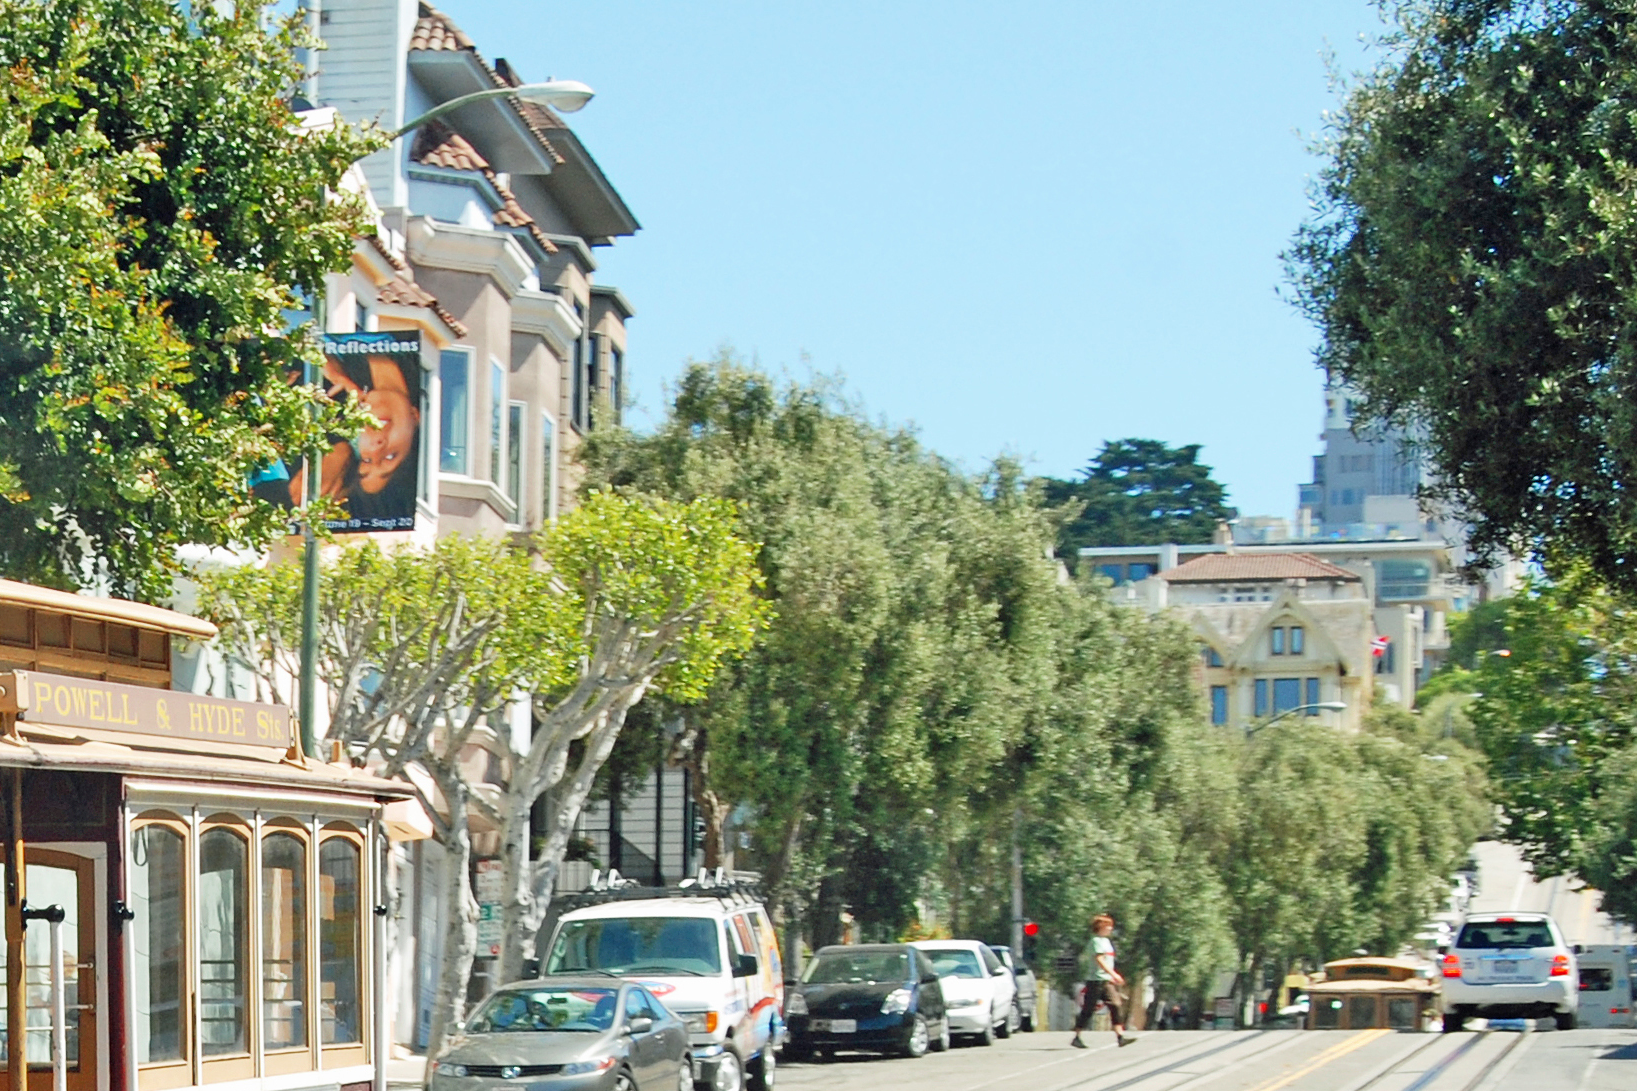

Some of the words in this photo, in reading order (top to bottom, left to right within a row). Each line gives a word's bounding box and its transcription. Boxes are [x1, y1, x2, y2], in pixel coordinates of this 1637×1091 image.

[325, 340, 419, 355] Reflections
[370, 517, 397, 531] Sept
[33, 681, 139, 727] POWELL
[155, 697, 172, 731] &
[188, 701, 246, 737] HYDE
[256, 709, 285, 741] Sts.
